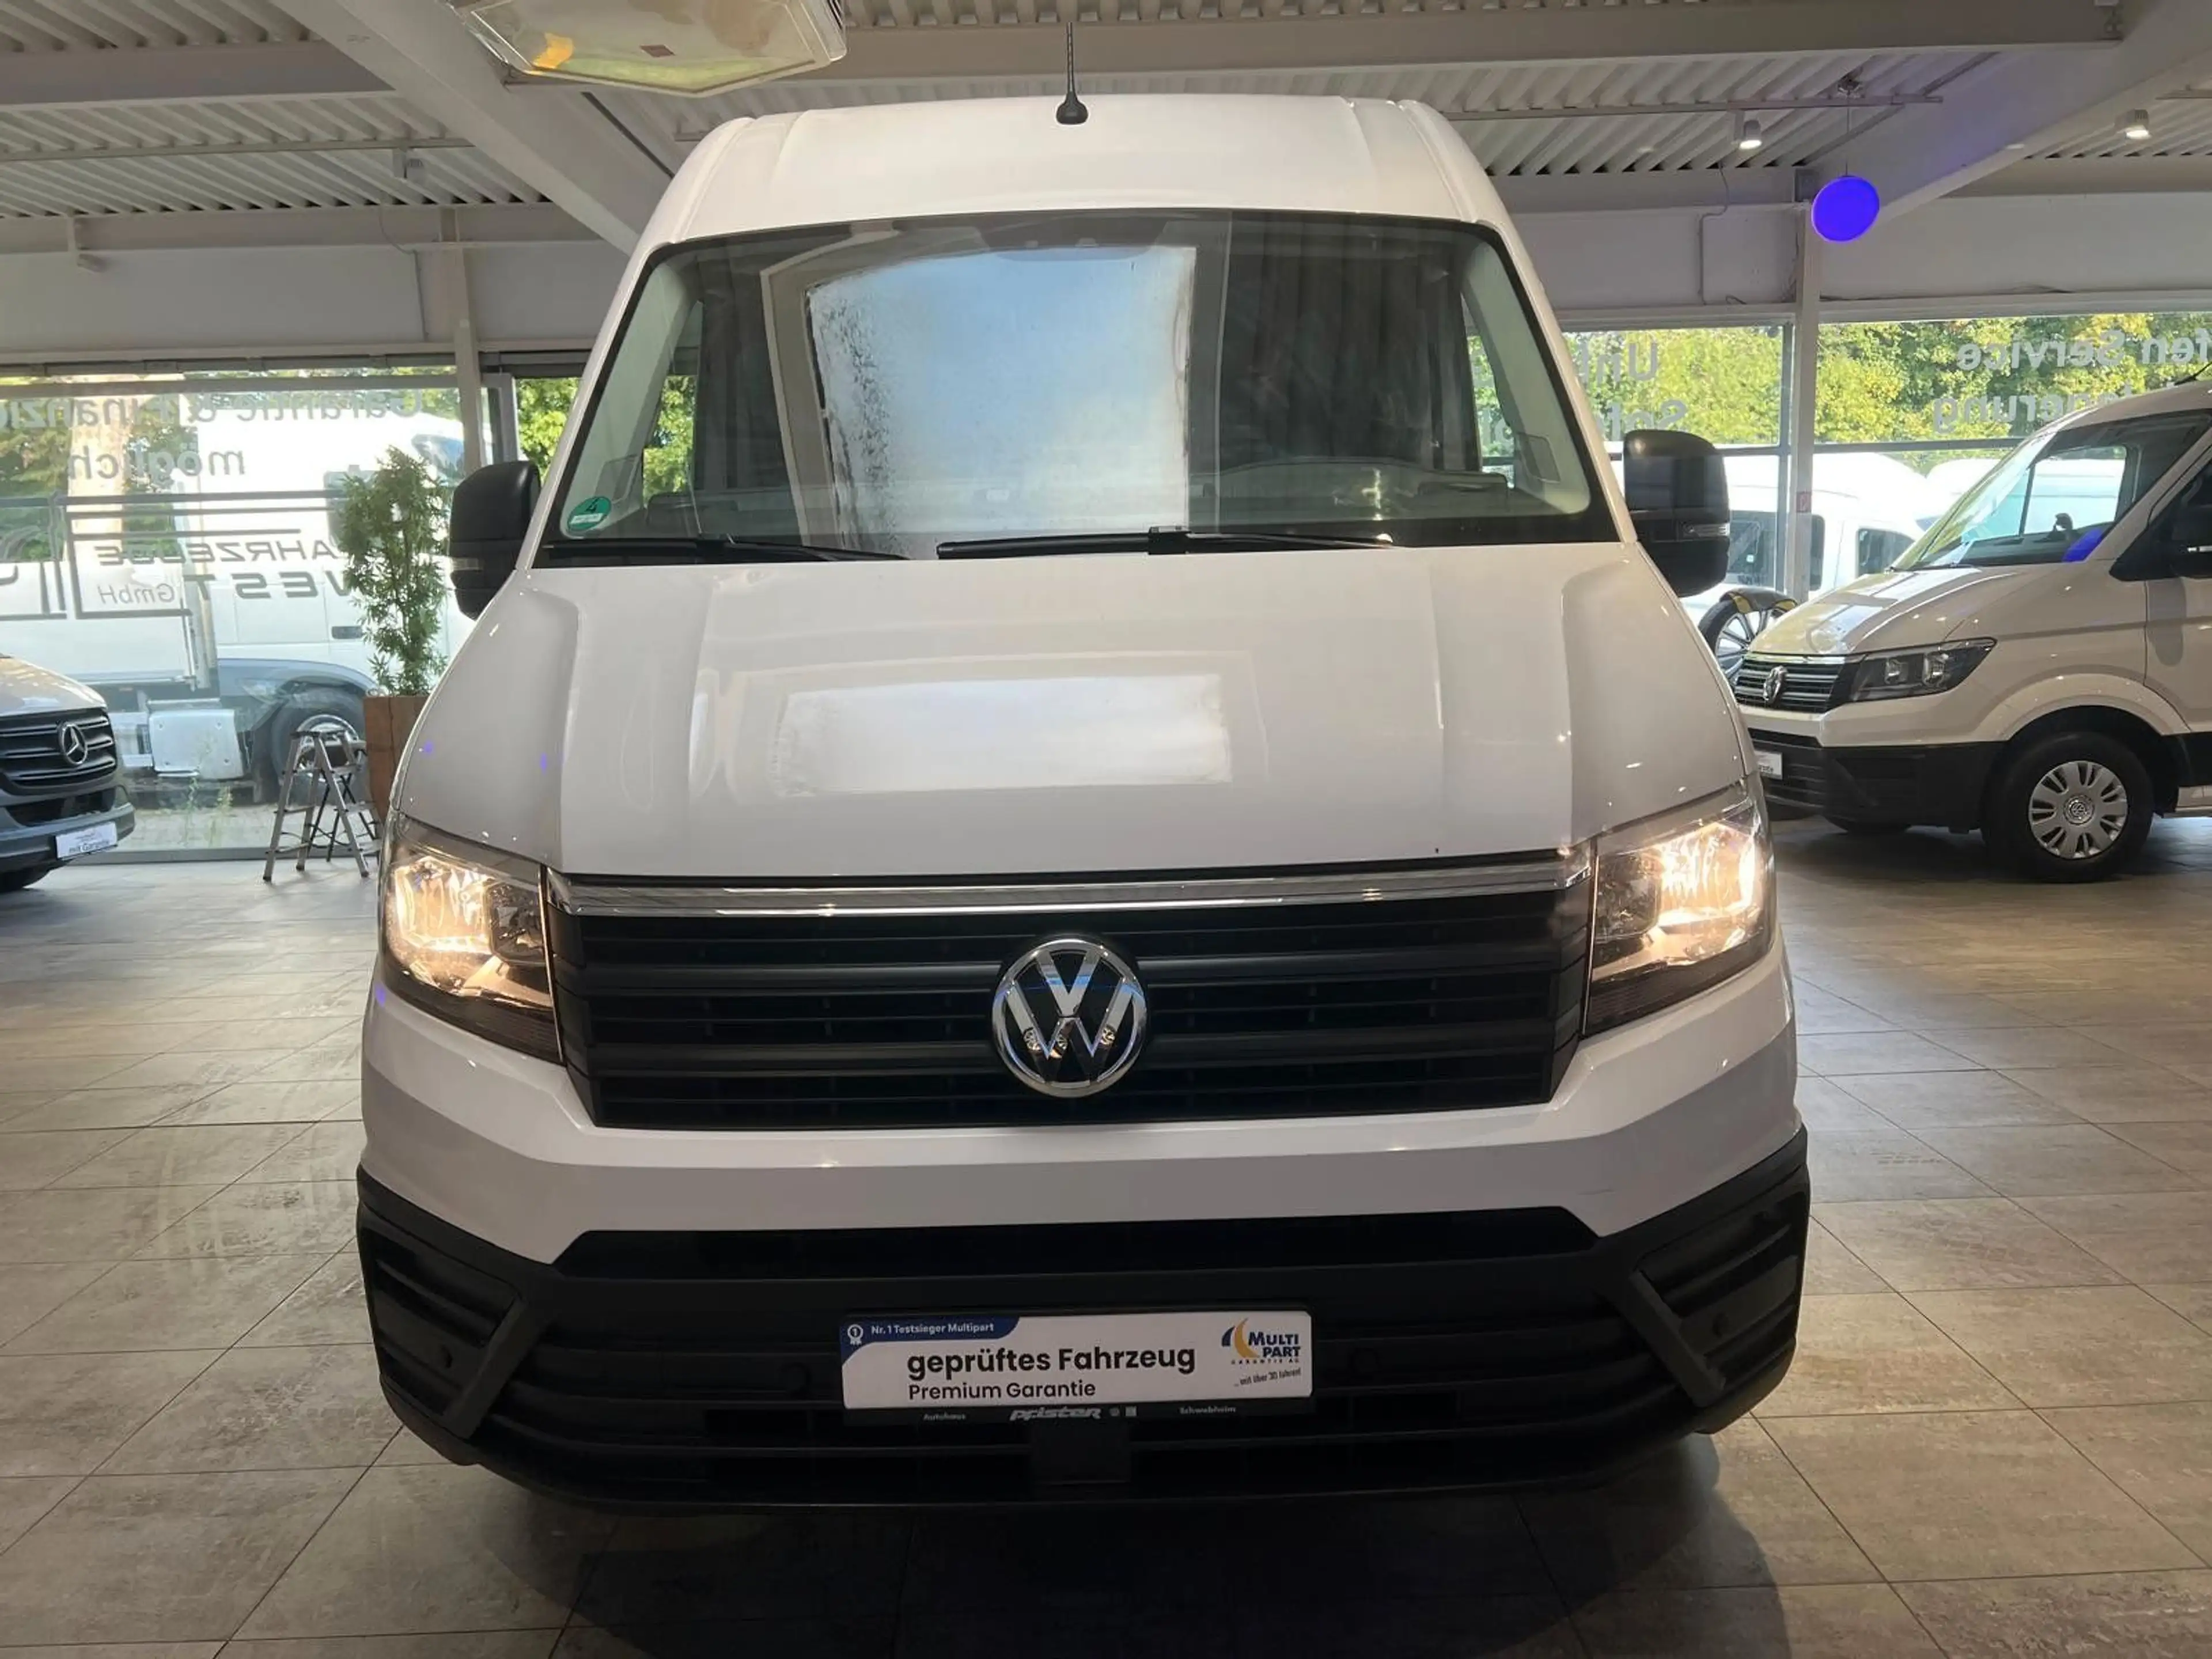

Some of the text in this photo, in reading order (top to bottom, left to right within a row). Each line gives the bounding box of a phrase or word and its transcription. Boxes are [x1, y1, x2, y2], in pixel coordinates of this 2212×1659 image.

[871, 1323, 994, 1336] Nr. 1 Testsieger Multipart
[1248, 1332, 1299, 1346] MULTI
[1262, 1346, 1301, 1357] PART
[907, 1346, 1195, 1381] geprüftes Fahrzeug
[909, 1380, 1096, 1400] Premium Garantie
